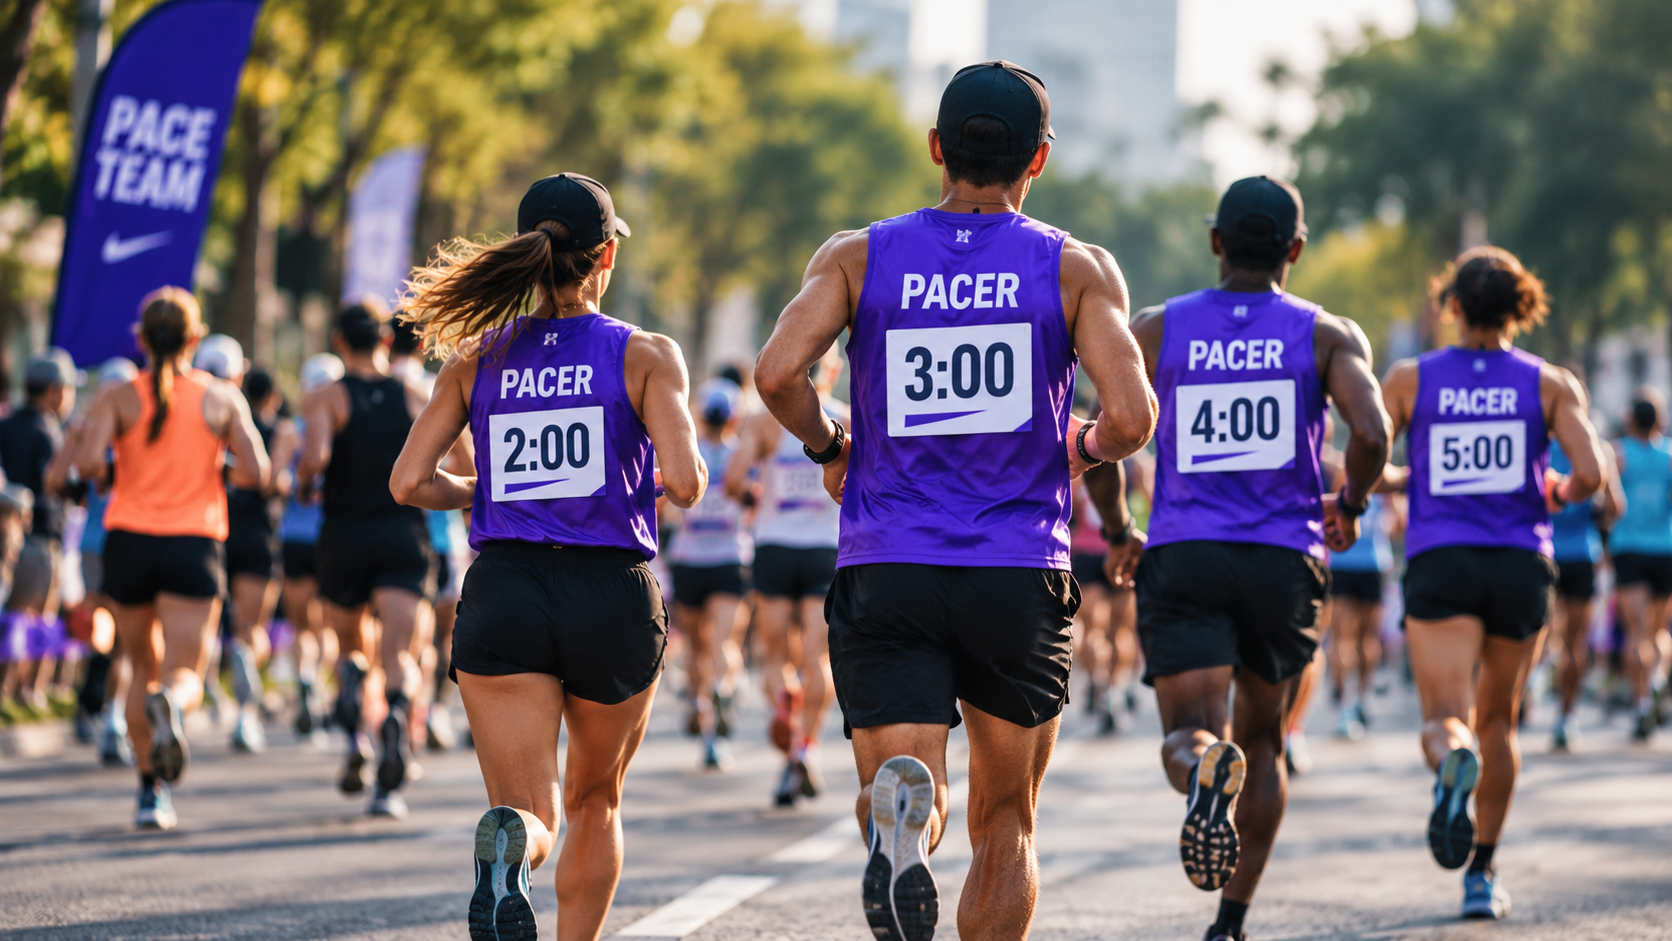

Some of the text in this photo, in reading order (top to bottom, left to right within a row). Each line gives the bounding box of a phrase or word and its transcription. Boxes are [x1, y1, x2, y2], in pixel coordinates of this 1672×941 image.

[103, 96, 216, 159] PACE
[95, 149, 206, 212] TEAM
[900, 272, 1020, 310] PACER
[904, 341, 1015, 402] 3:00
[1188, 339, 1284, 371] PACER
[500, 364, 594, 399] PACER
[1438, 387, 1518, 416] PACER
[1190, 395, 1280, 444] 4:00
[503, 422, 590, 473] 2:00
[1442, 434, 1513, 472] 5:00
